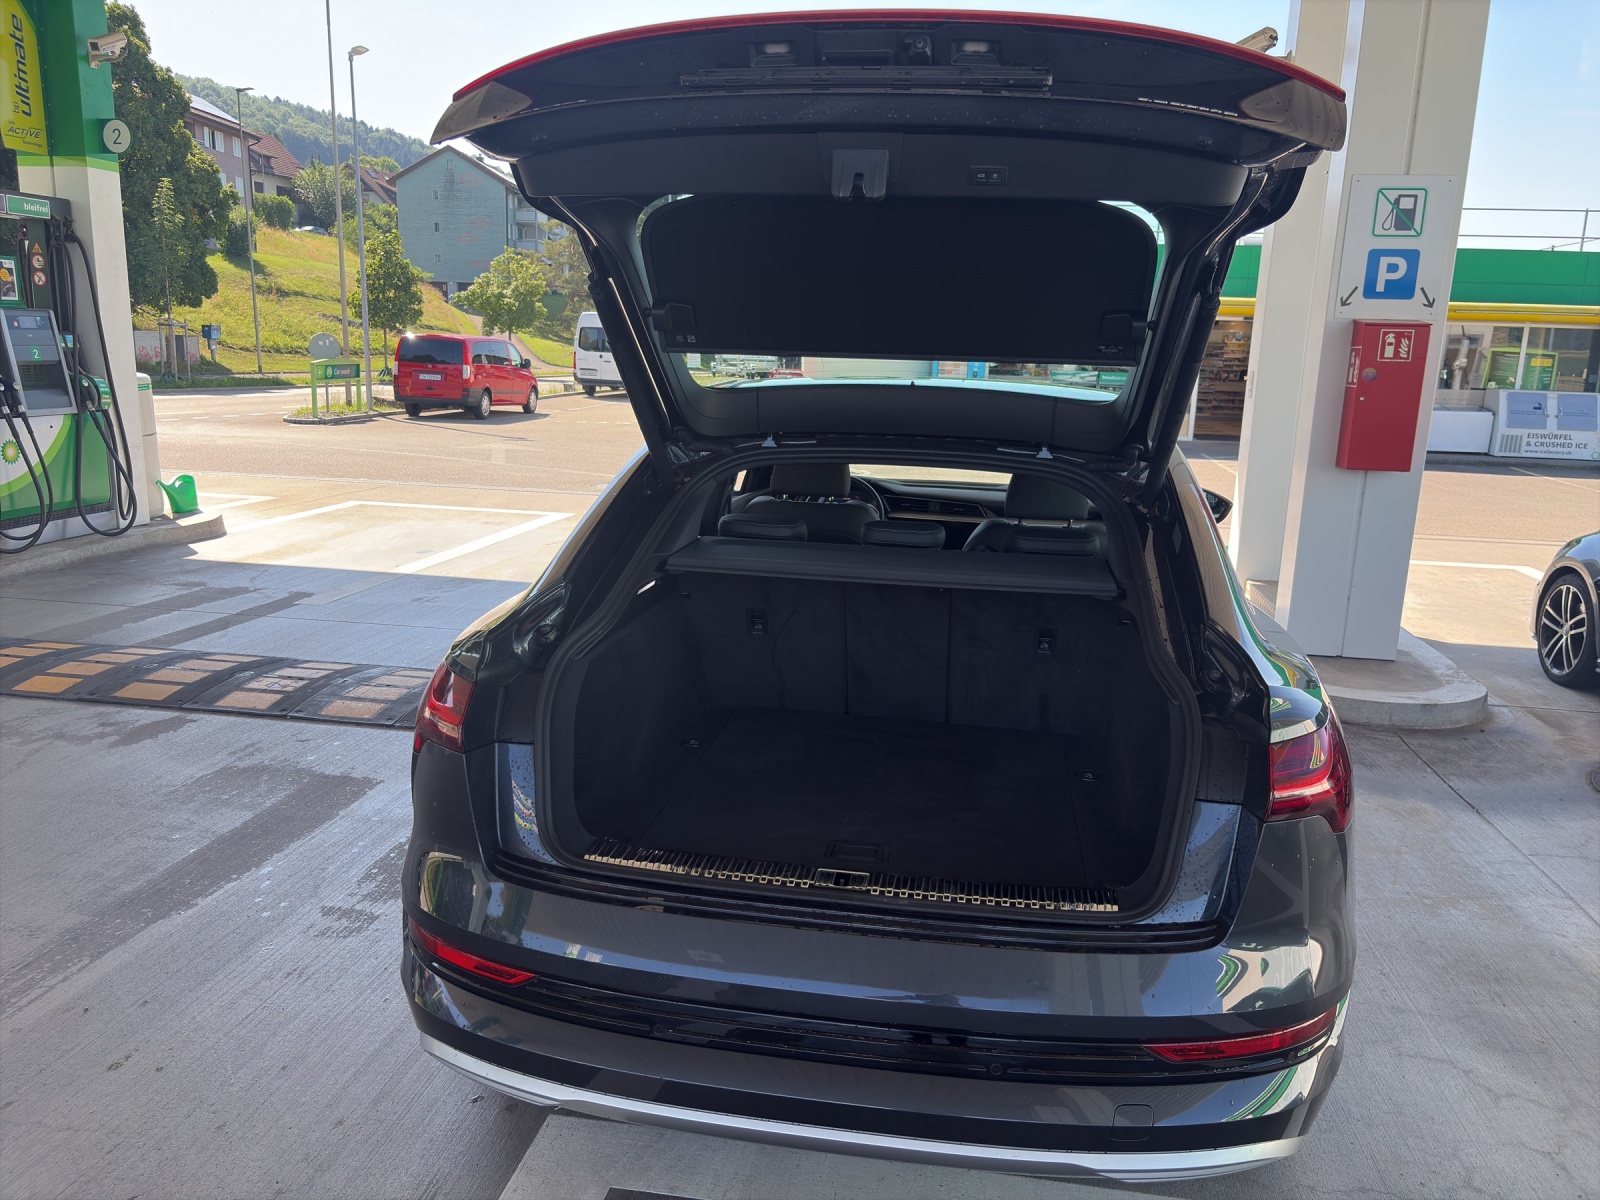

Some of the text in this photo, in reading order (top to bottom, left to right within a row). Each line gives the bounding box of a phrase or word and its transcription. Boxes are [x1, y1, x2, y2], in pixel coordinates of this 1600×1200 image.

[9, 13, 32, 118] ultimate
[13, 101, 21, 114] bp
[8, 126, 41, 139] ACTIVE
[112, 128, 122, 145] 2
[23, 202, 49, 213] bleifrei
[1375, 256, 1408, 293] P
[33, 349, 40, 359] 2
[1526, 432, 1573, 441] EISWÜRFEL
[1534, 441, 1573, 449] CRUSHED
